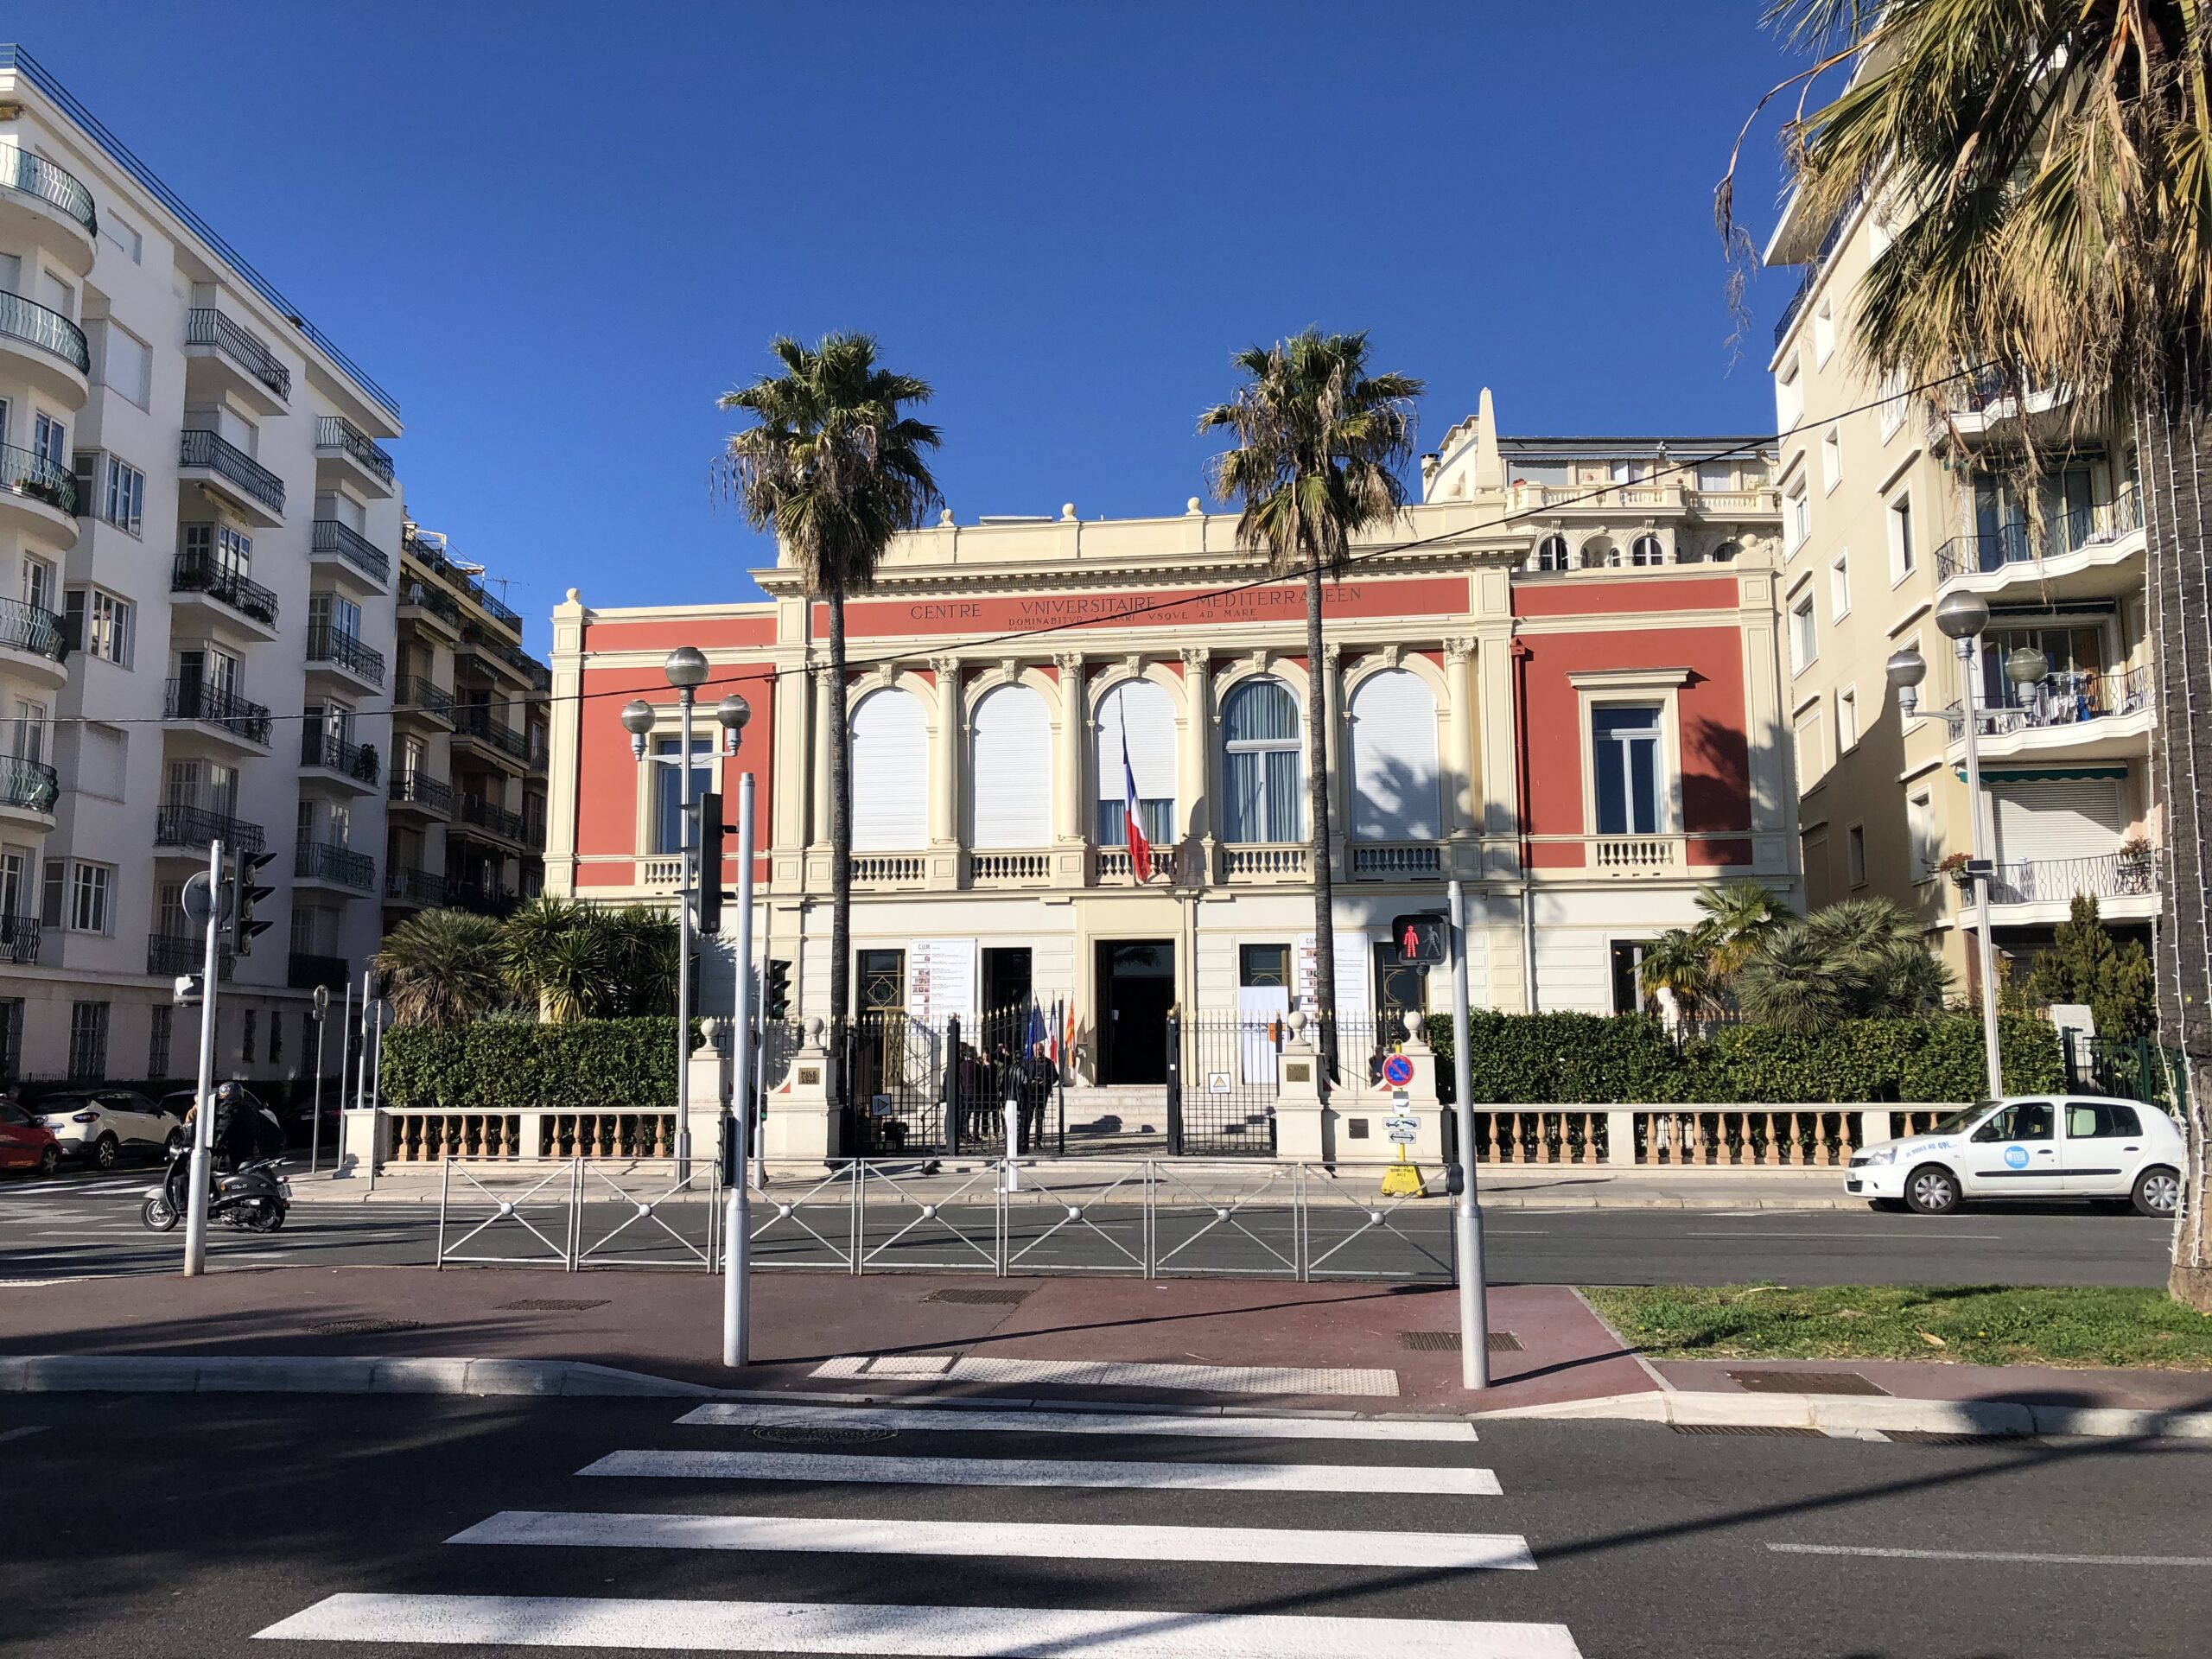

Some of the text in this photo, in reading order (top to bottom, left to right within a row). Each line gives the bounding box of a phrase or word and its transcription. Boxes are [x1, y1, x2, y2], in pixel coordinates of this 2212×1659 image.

[911, 587, 1361, 620] CENTRE VNIVERSITAIRE MEDITERRAEEN
[1148, 612, 1188, 620] VSQVE
[1199, 609, 1213, 619] AD
[1224, 608, 1257, 618] MARE
